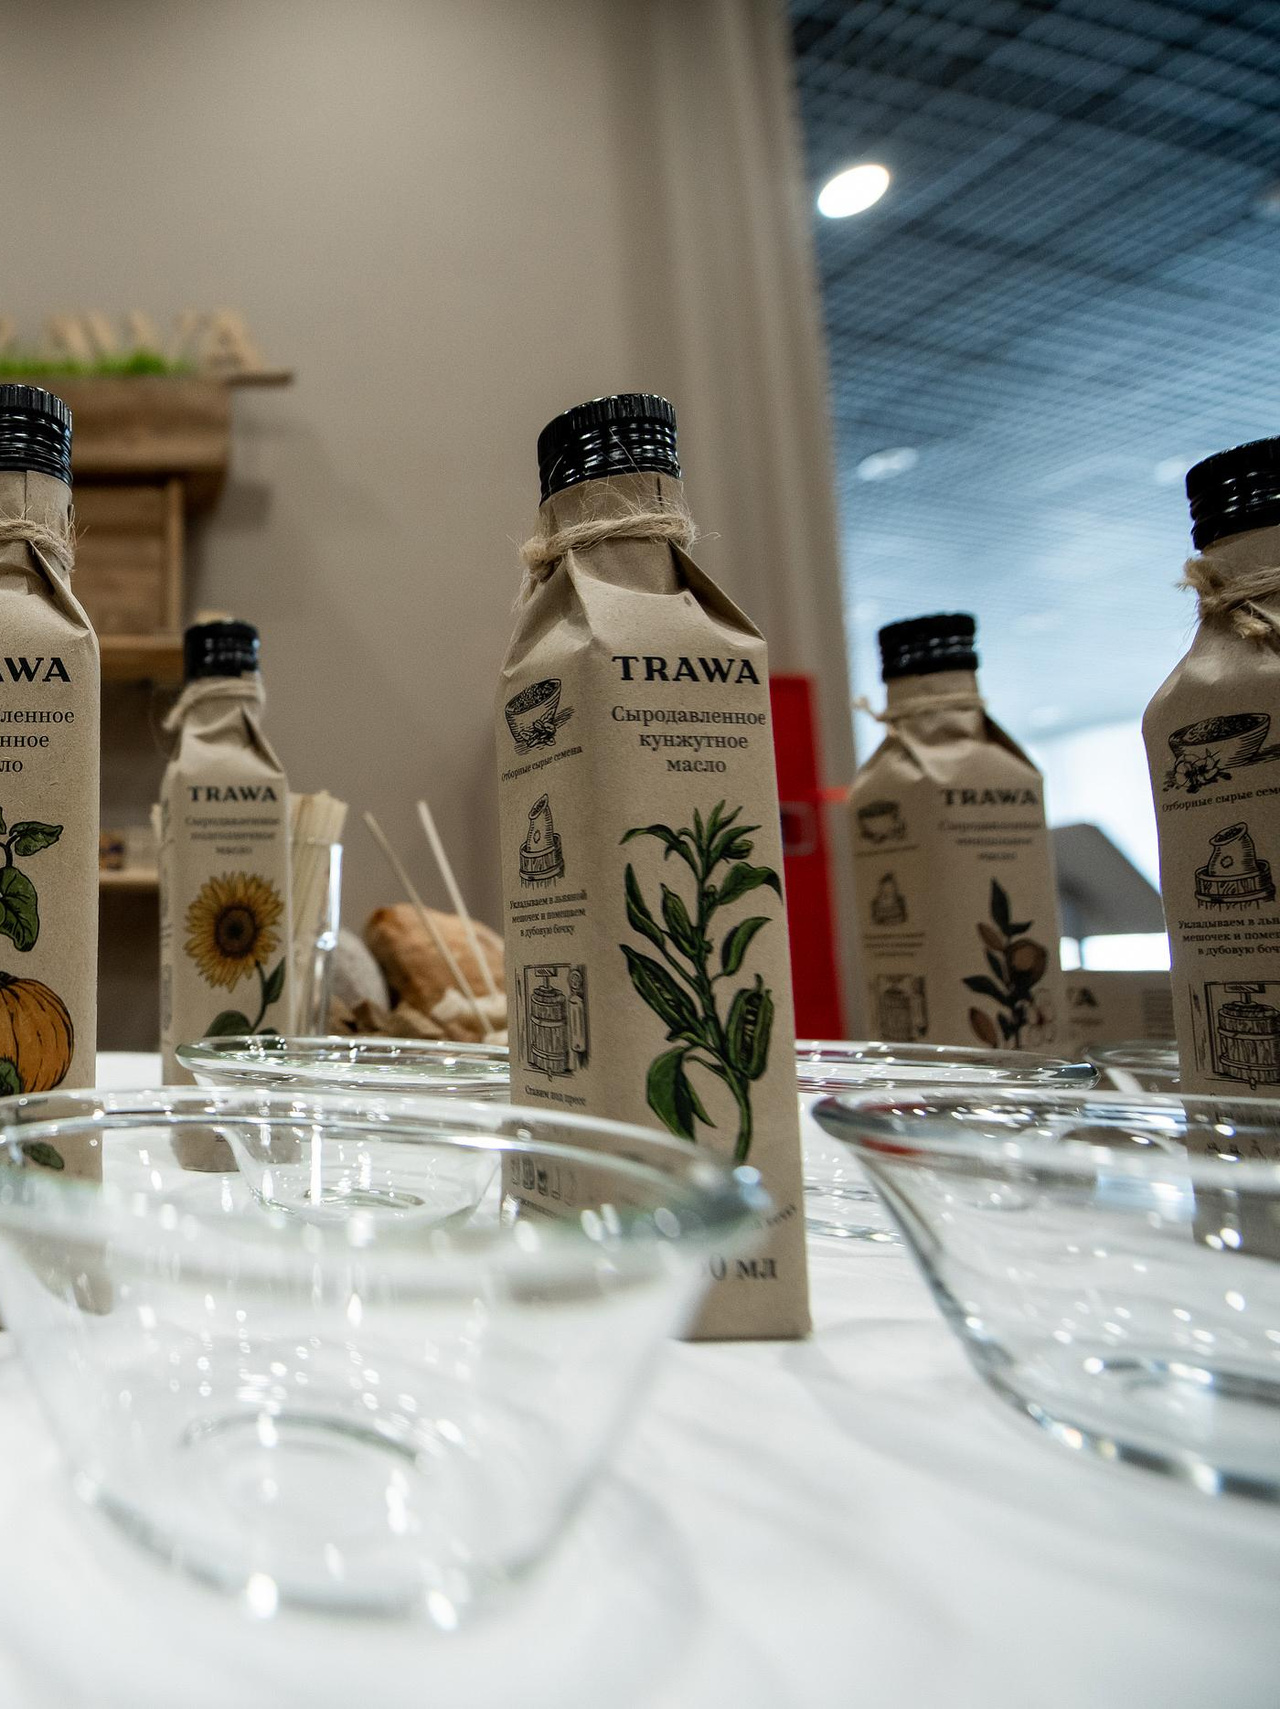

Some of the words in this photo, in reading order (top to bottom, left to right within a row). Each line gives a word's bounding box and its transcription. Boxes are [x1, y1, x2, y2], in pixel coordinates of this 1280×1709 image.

[613, 656, 760, 684] TRAWA
[611, 706, 766, 727] Сыродавленное
[639, 733, 748, 752] кунжутное
[553, 746, 583, 761] семена
[666, 759, 726, 773] масло
[187, 786, 277, 801] TRAWA
[939, 788, 1039, 806] TRAWA
[1162, 799, 1213, 812] Отборные
[1215, 791, 1253, 804] сырые
[1256, 786, 1280, 797] сем
[1179, 920, 1245, 929] Укладываем
[1257, 917, 1280, 925] льн
[1182, 934, 1231, 942] мешочек
[1244, 931, 1280, 940] поме
[1206, 945, 1254, 957] дубовую
[1257, 944, 1280, 953] боч
[736, 1258, 777, 1279] мл
